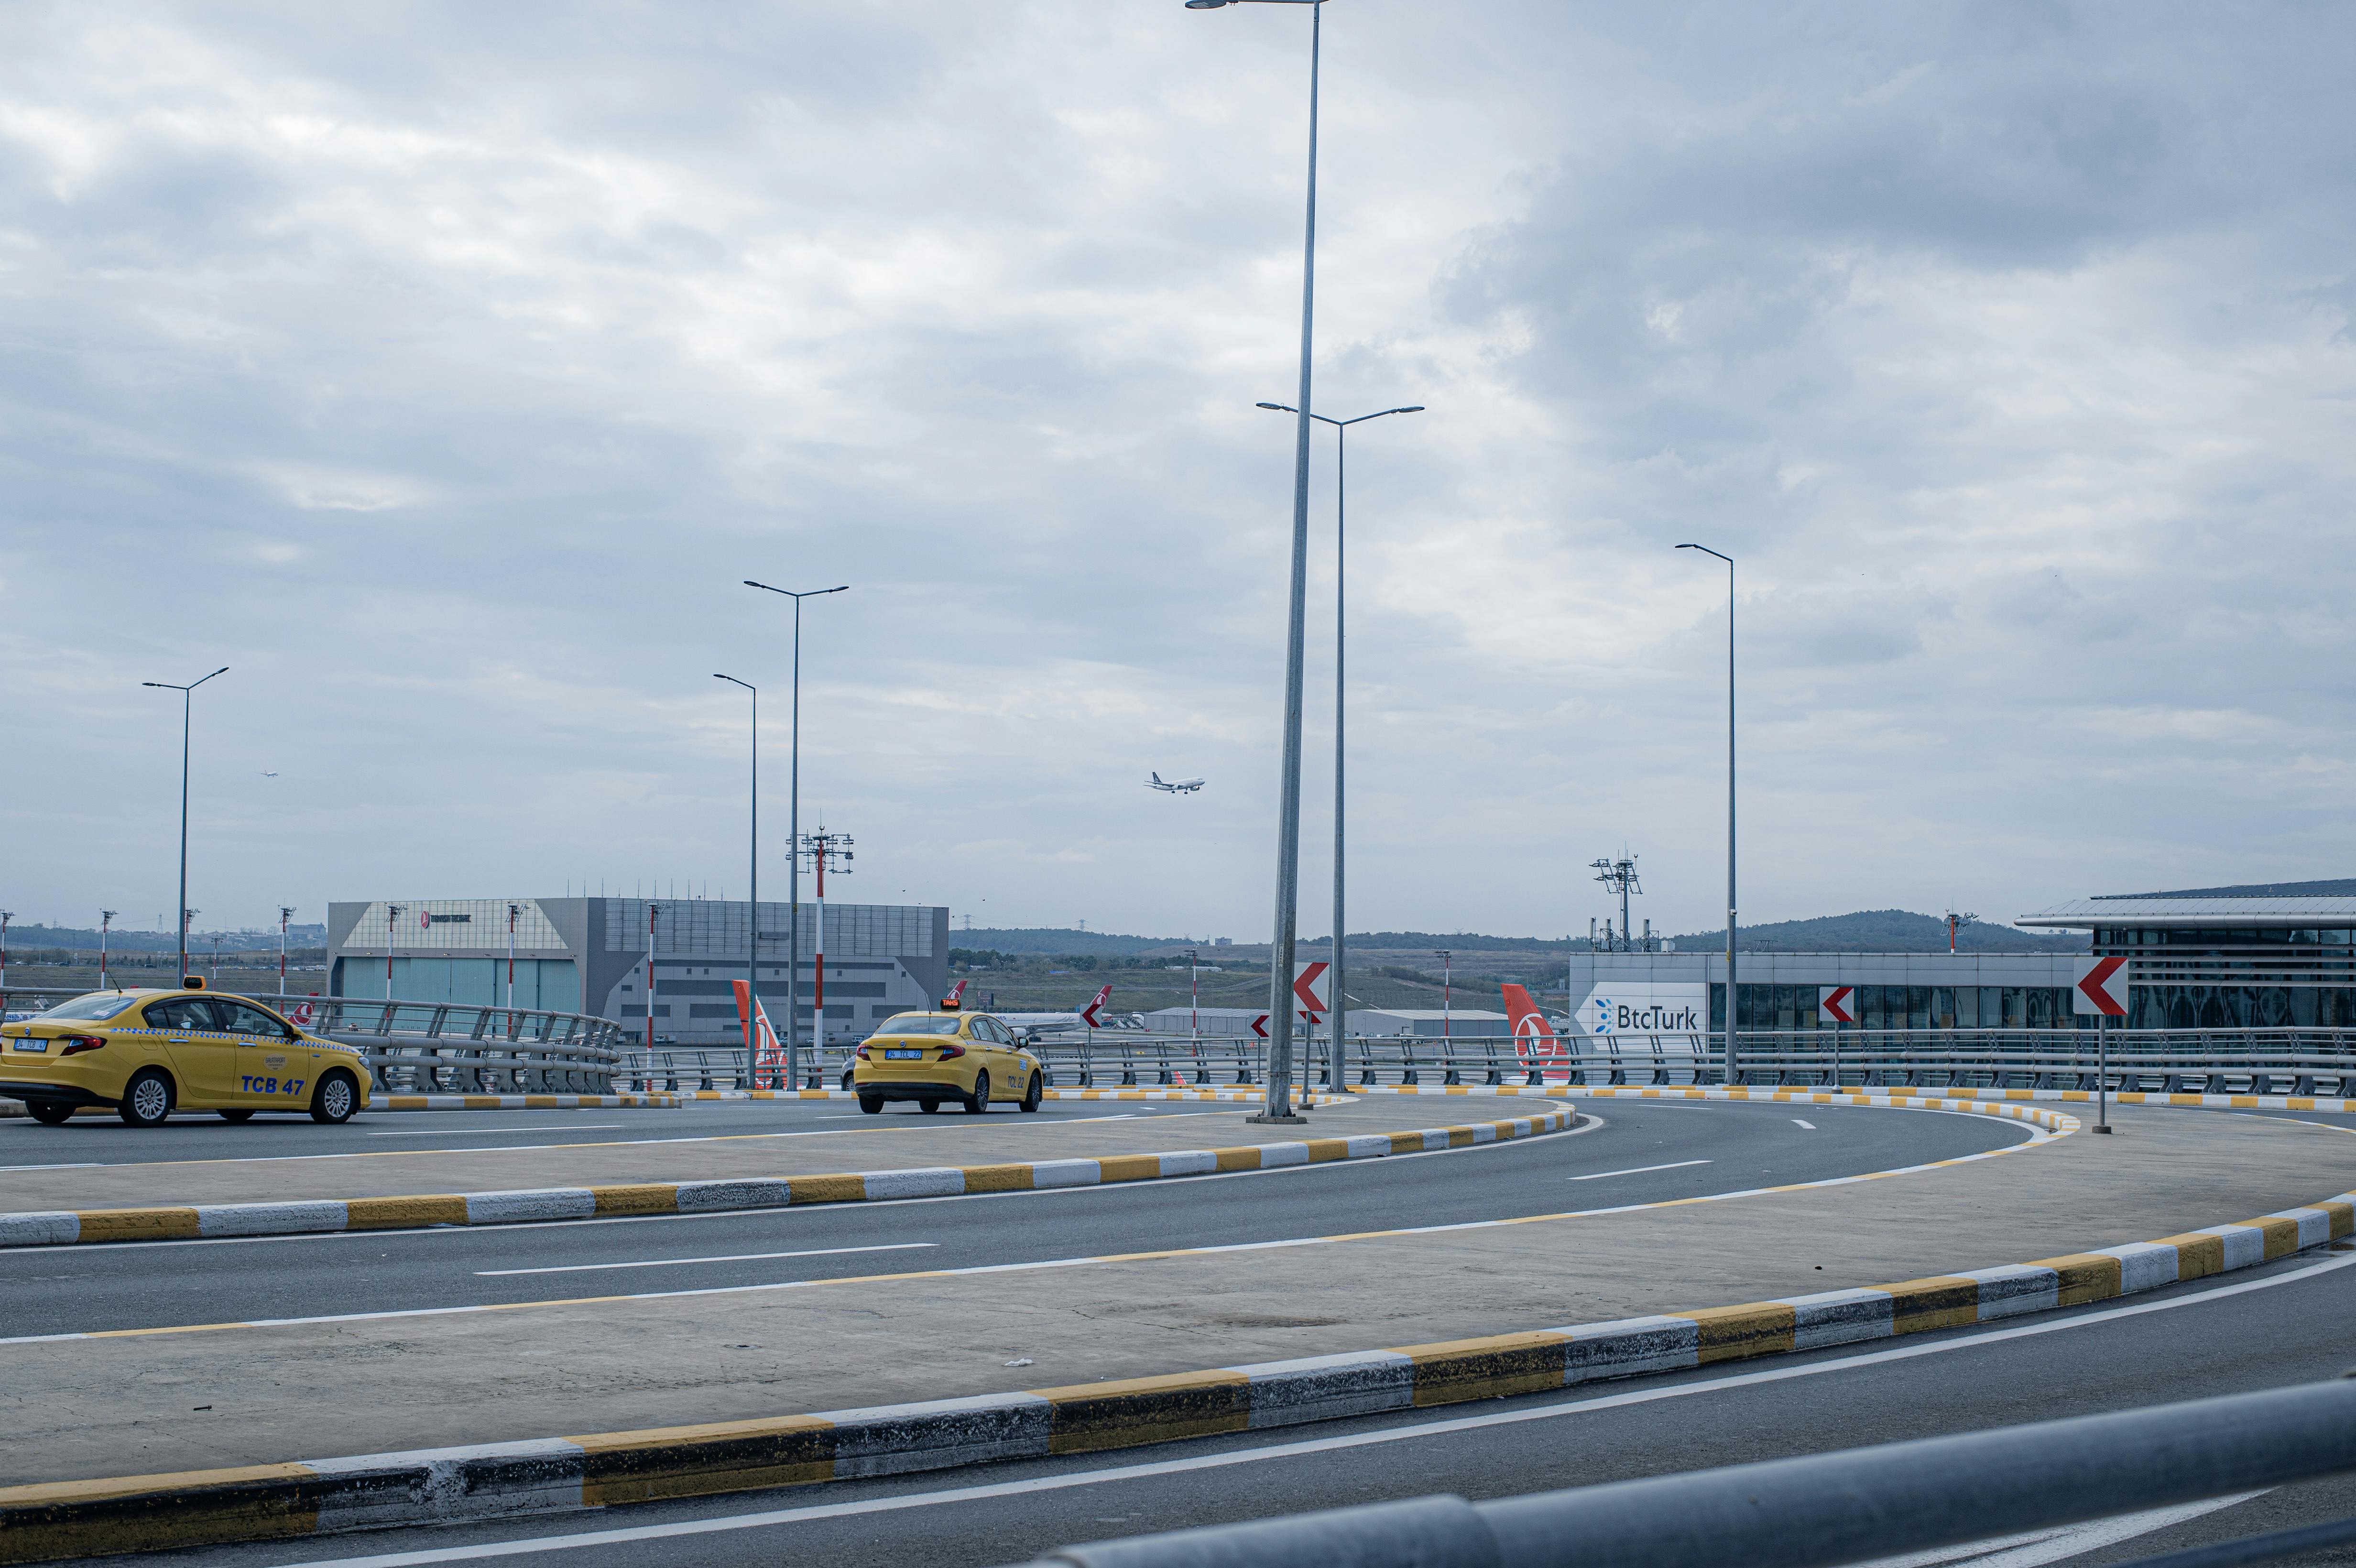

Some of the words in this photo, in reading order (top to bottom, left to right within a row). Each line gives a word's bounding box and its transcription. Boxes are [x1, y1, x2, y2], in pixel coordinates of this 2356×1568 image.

[1618, 1005, 1697, 1030] BtcTurk
[17, 1040, 23, 1048] 34
[27, 1040, 36, 1048] TCB
[39, 1041, 46, 1049] 47
[241, 1076, 277, 1093] TCB
[282, 1078, 305, 1096] 47
[1008, 1075, 1016, 1088] TCL
[1017, 1077, 1024, 1089] 22
